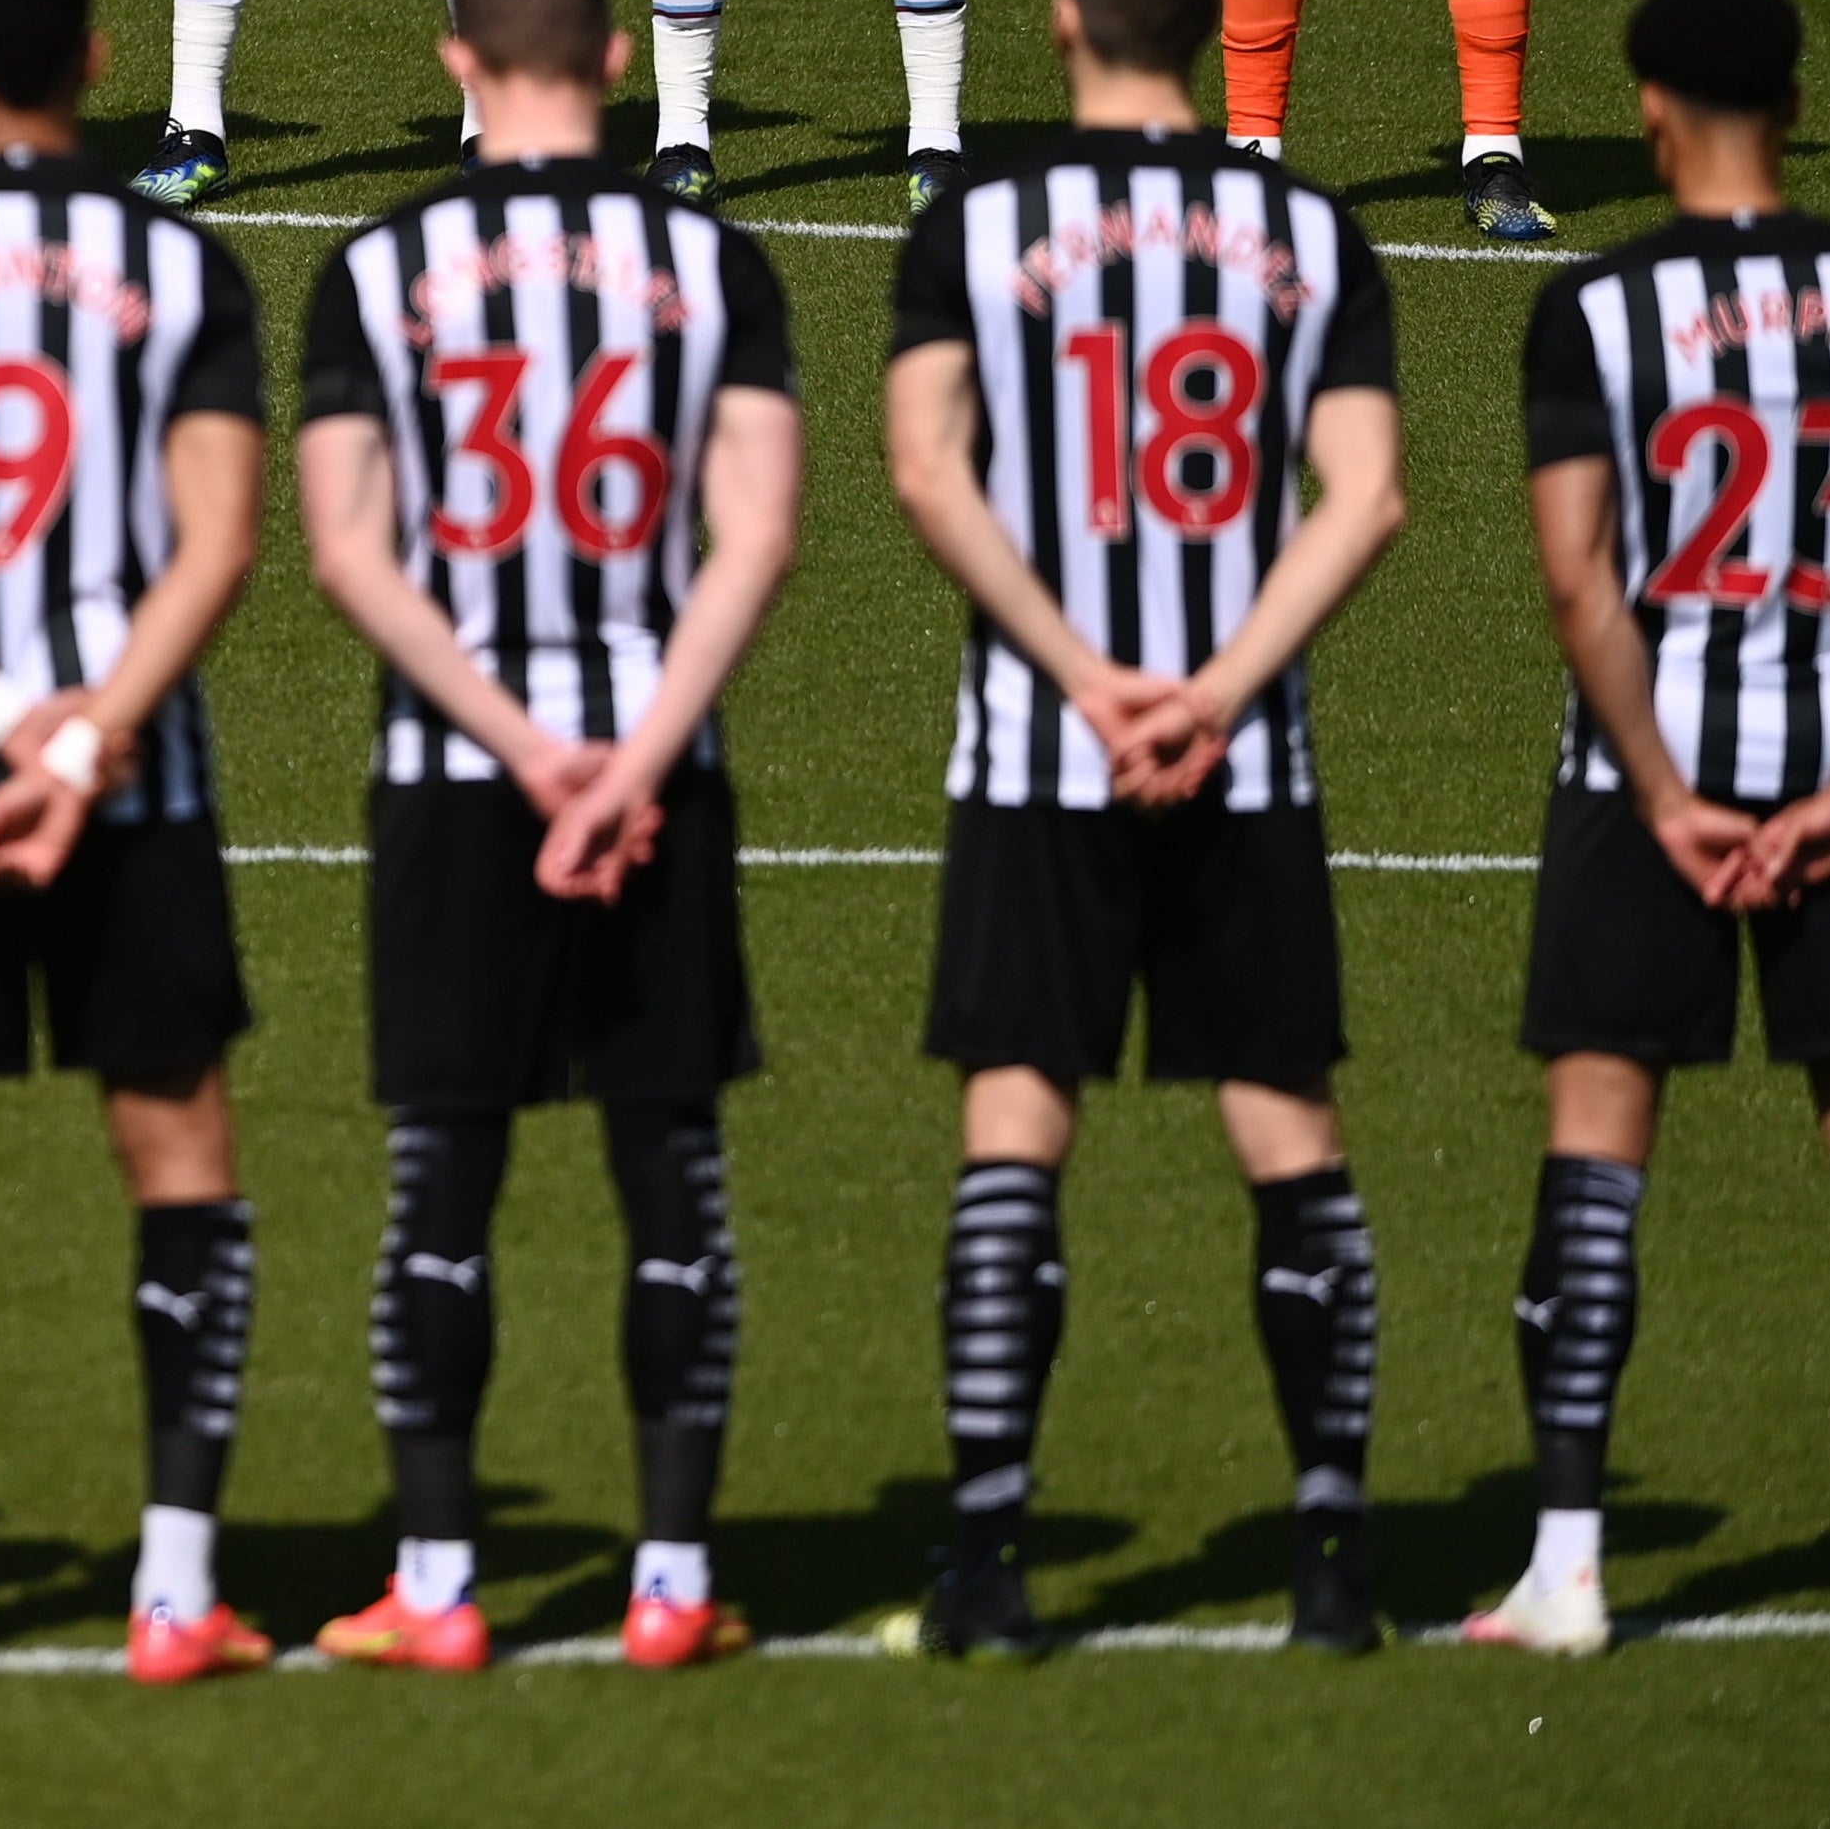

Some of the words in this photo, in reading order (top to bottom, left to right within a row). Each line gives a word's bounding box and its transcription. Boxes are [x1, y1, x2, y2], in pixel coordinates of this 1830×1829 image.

[1061, 315, 1268, 542] 18
[1666, 288, 1830, 367] MURP
[426, 342, 672, 560] 36
